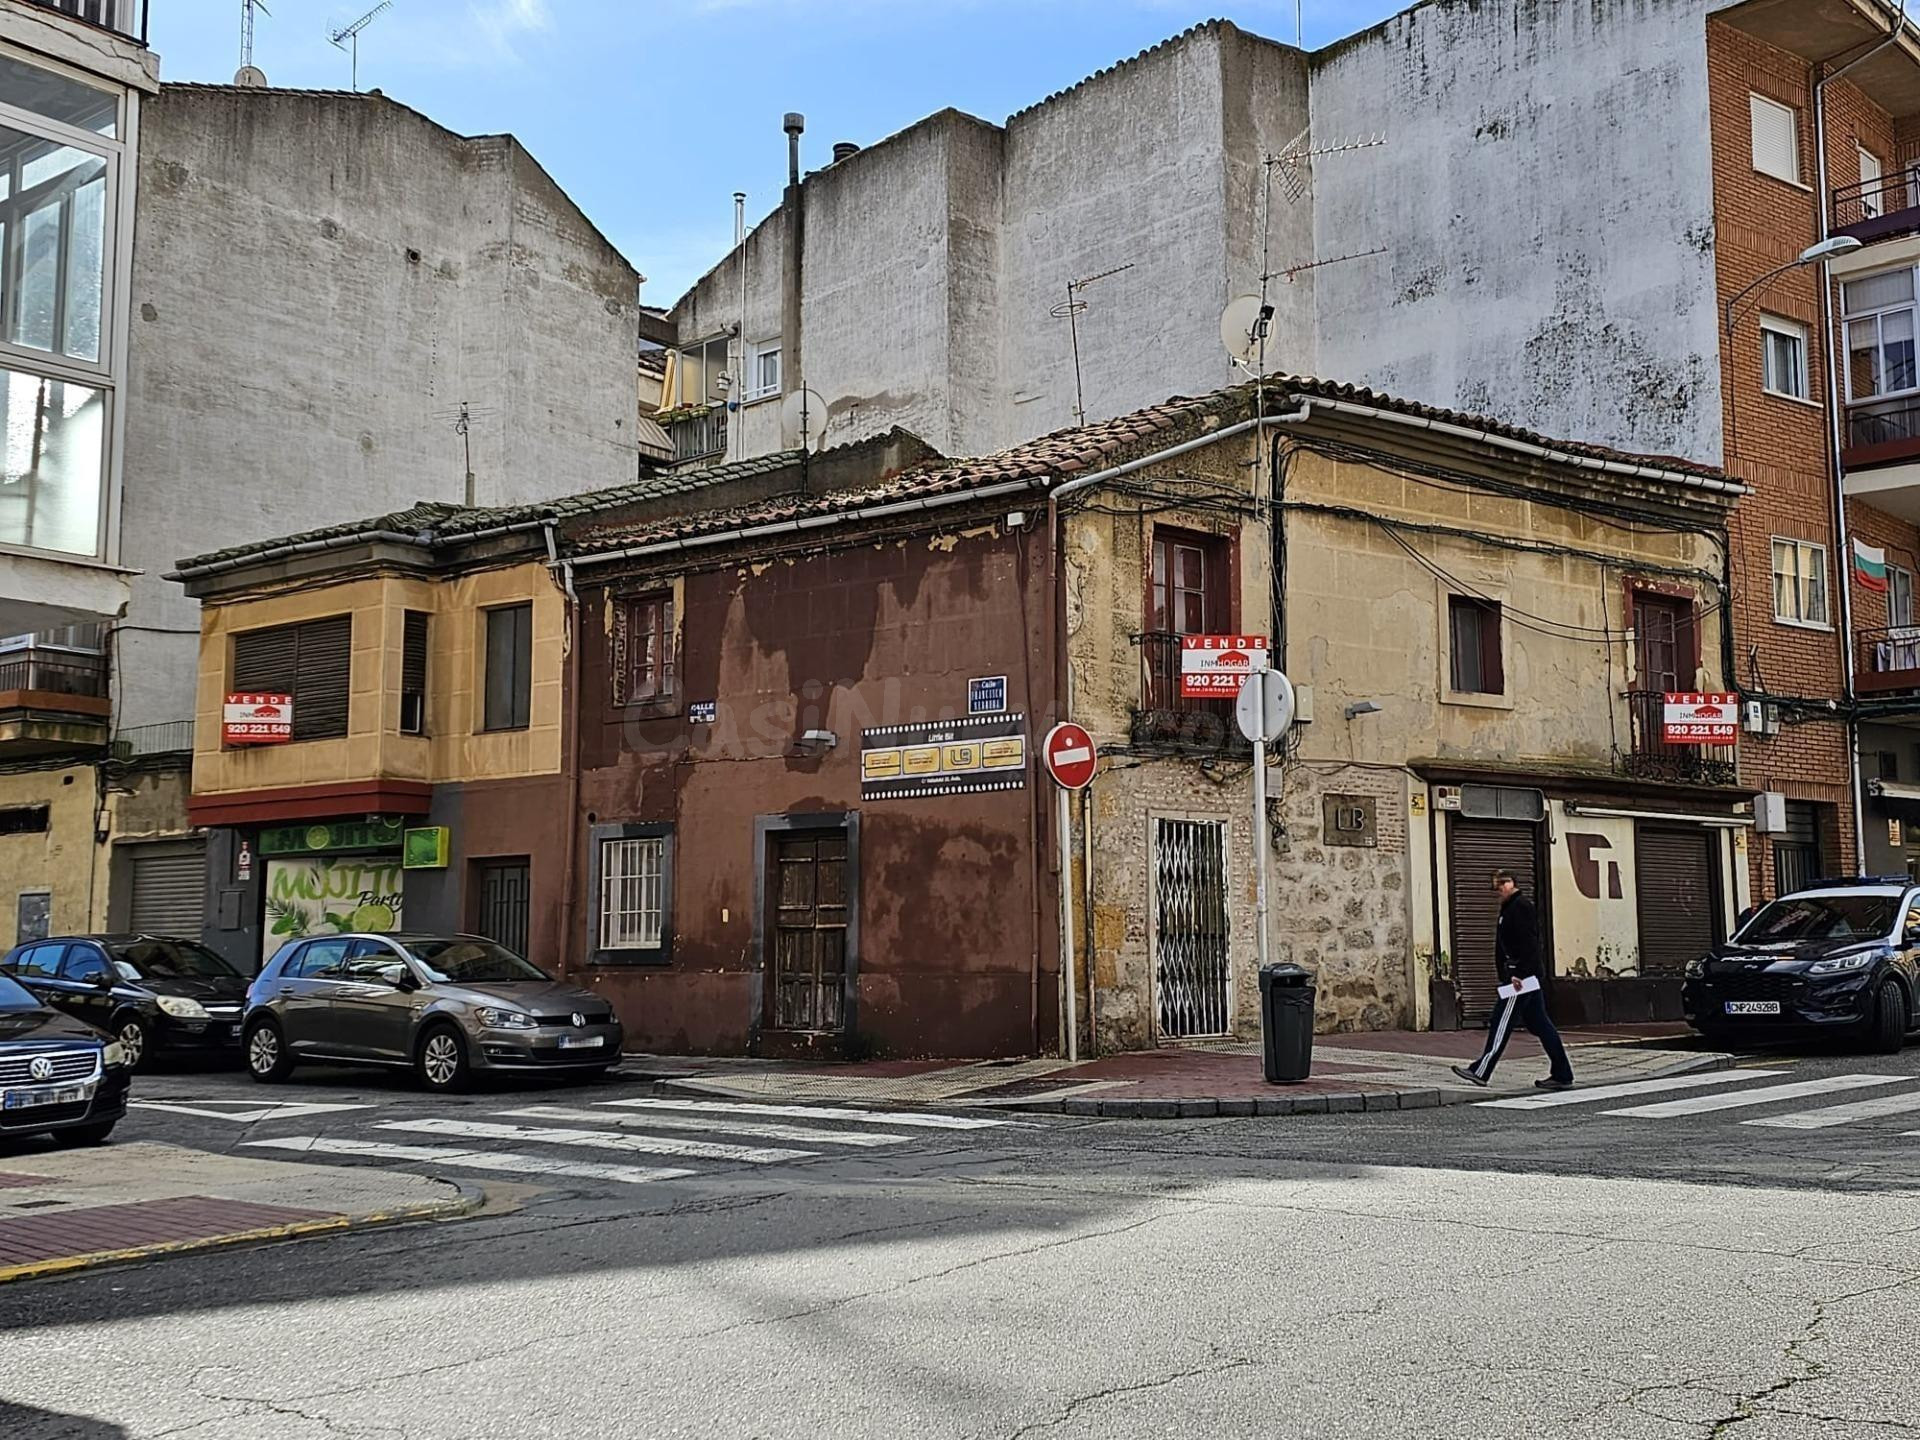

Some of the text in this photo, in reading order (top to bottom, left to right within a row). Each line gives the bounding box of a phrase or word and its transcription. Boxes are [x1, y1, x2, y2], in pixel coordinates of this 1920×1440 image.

[1187, 638, 1263, 649] VENDE
[1200, 659, 1249, 668] INMHOGAR
[1186, 675, 1210, 687] 920
[1211, 675, 1236, 687] 221
[228, 695, 293, 705] VENDE
[1667, 695, 1735, 704] VENDE
[227, 724, 291, 734] 920 221 549
[1667, 725, 1734, 735] 920 221 549
[358, 891, 403, 913] Party
